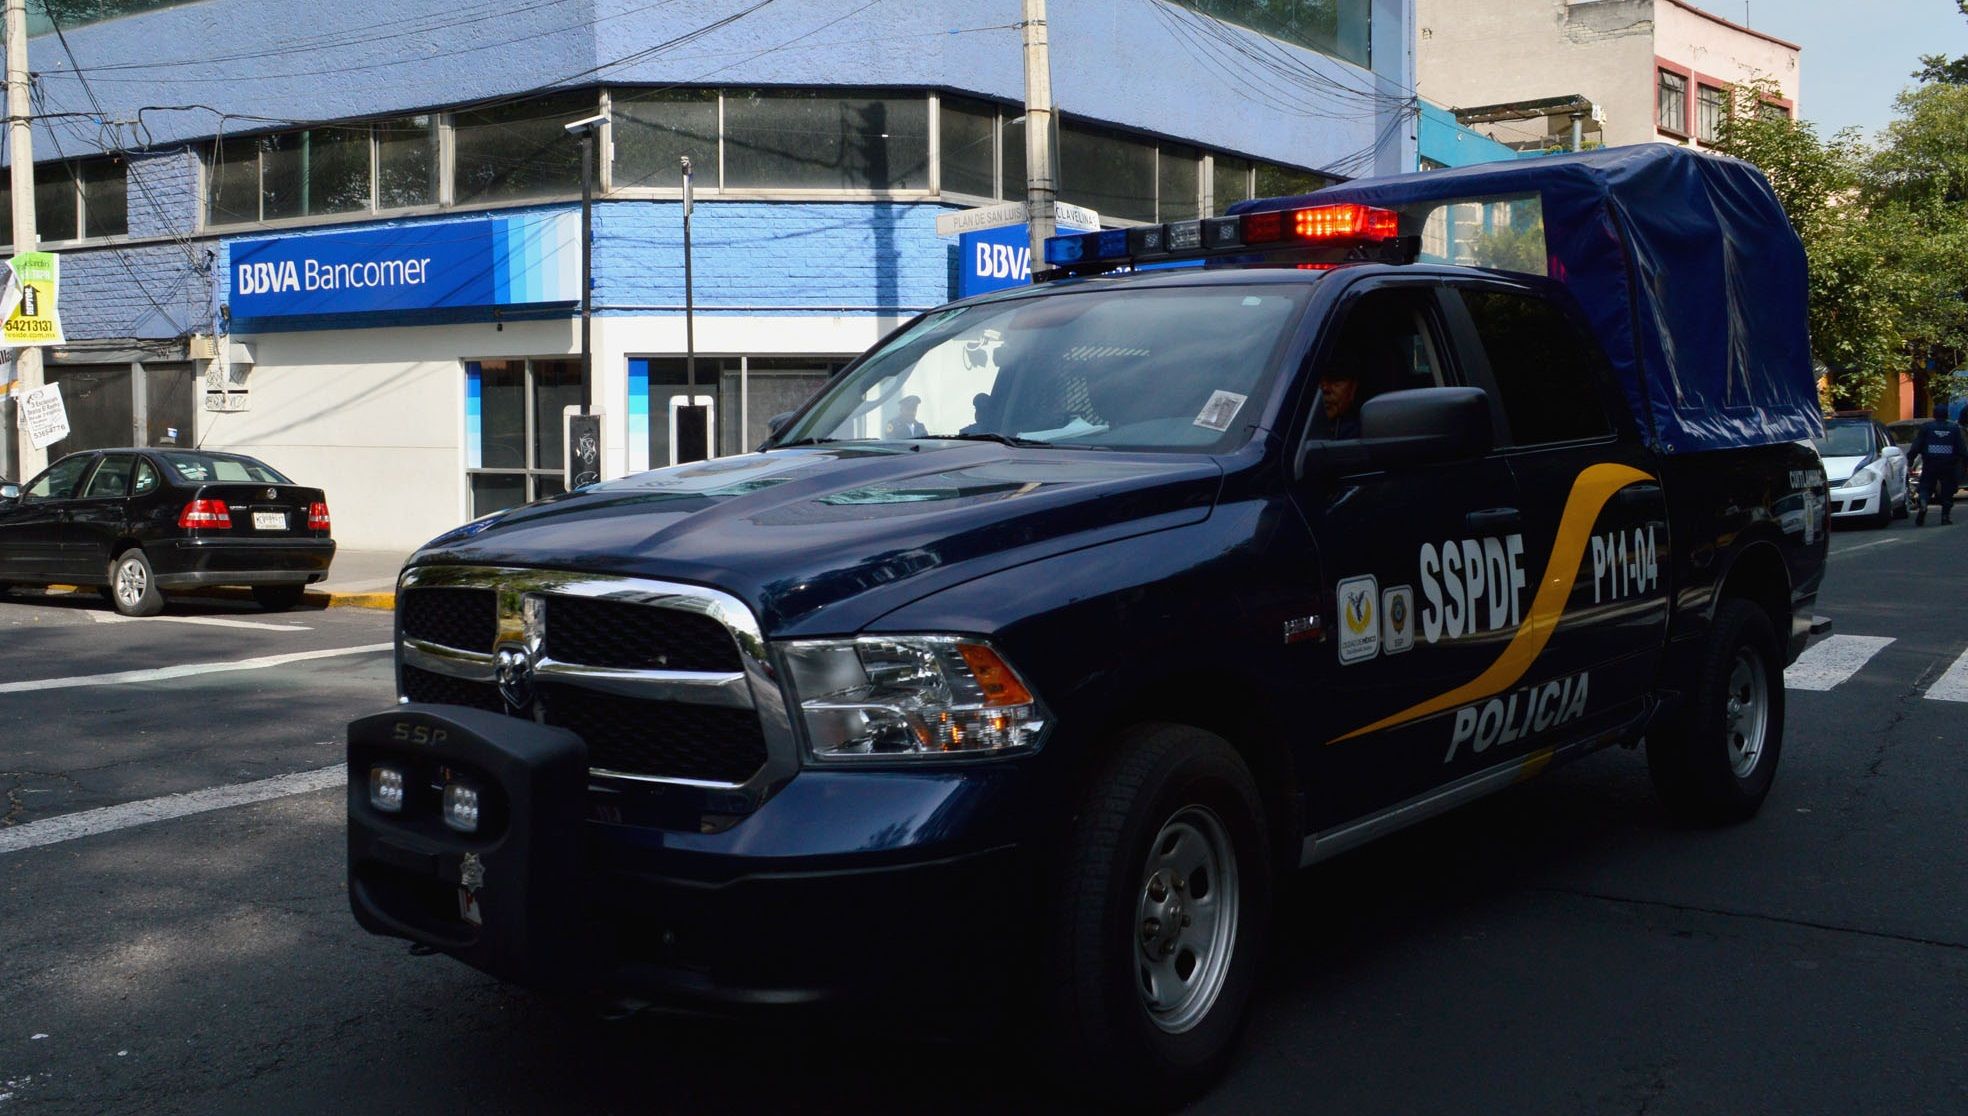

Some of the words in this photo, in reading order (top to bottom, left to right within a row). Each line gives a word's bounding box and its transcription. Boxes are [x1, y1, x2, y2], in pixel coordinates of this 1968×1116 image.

[953, 216, 974, 228] PLAN
[975, 214, 987, 225] DE
[987, 211, 1003, 223] SAN
[1004, 208, 1022, 220] LUIS
[239, 261, 300, 294] BBVA
[305, 258, 430, 290] Bancomer
[6, 320, 53, 332] 54213137
[1592, 525, 1658, 603] P11-04
[1420, 533, 1526, 644] SSPDF
[393, 723, 448, 745] SSP
[1444, 672, 1590, 763] POLICIA
